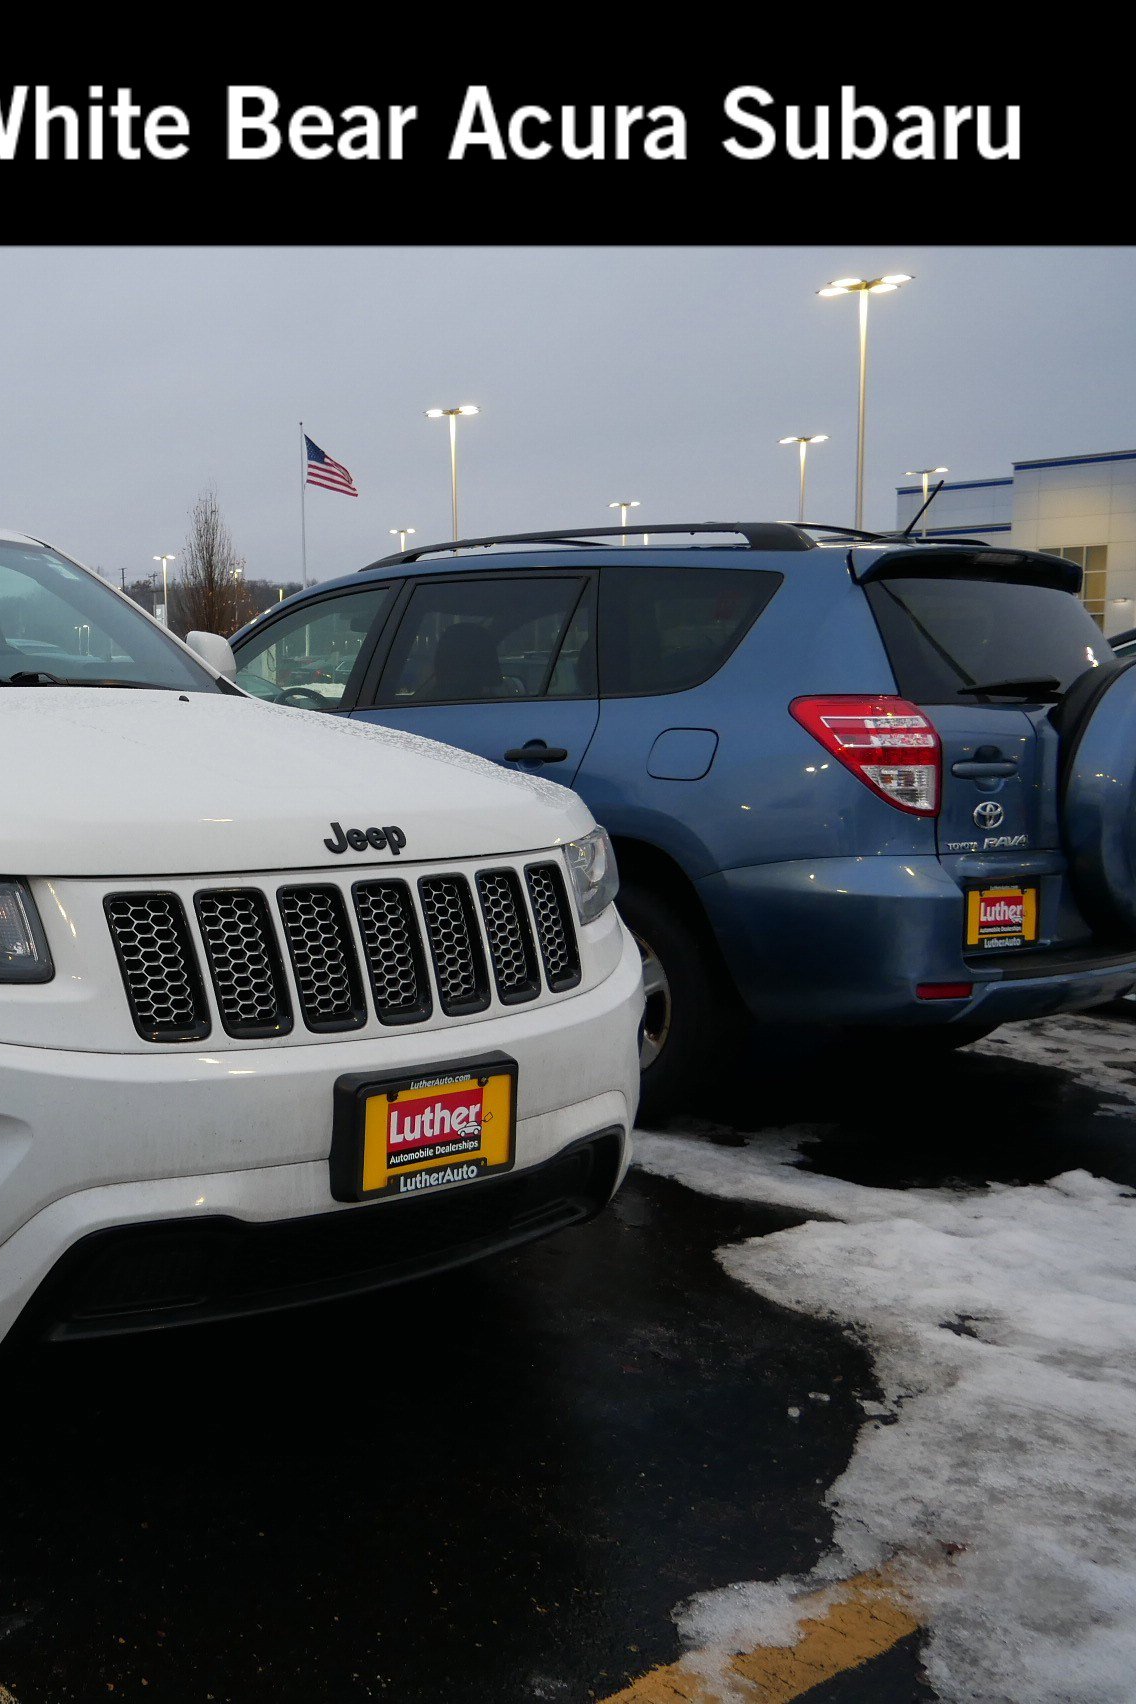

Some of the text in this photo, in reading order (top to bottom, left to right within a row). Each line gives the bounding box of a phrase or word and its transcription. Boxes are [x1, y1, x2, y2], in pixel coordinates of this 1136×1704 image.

[323, 821, 407, 856] Jeep
[947, 841, 978, 851] TOYOTA
[980, 901, 1023, 921] Luther
[984, 938, 1020, 948] LutherAuto
[410, 1074, 471, 1090] LutherAuto.com
[390, 1103, 481, 1144] Luther
[389, 1140, 479, 1165] Automobile Dealerships
[400, 1164, 478, 1192] LutherAuto
